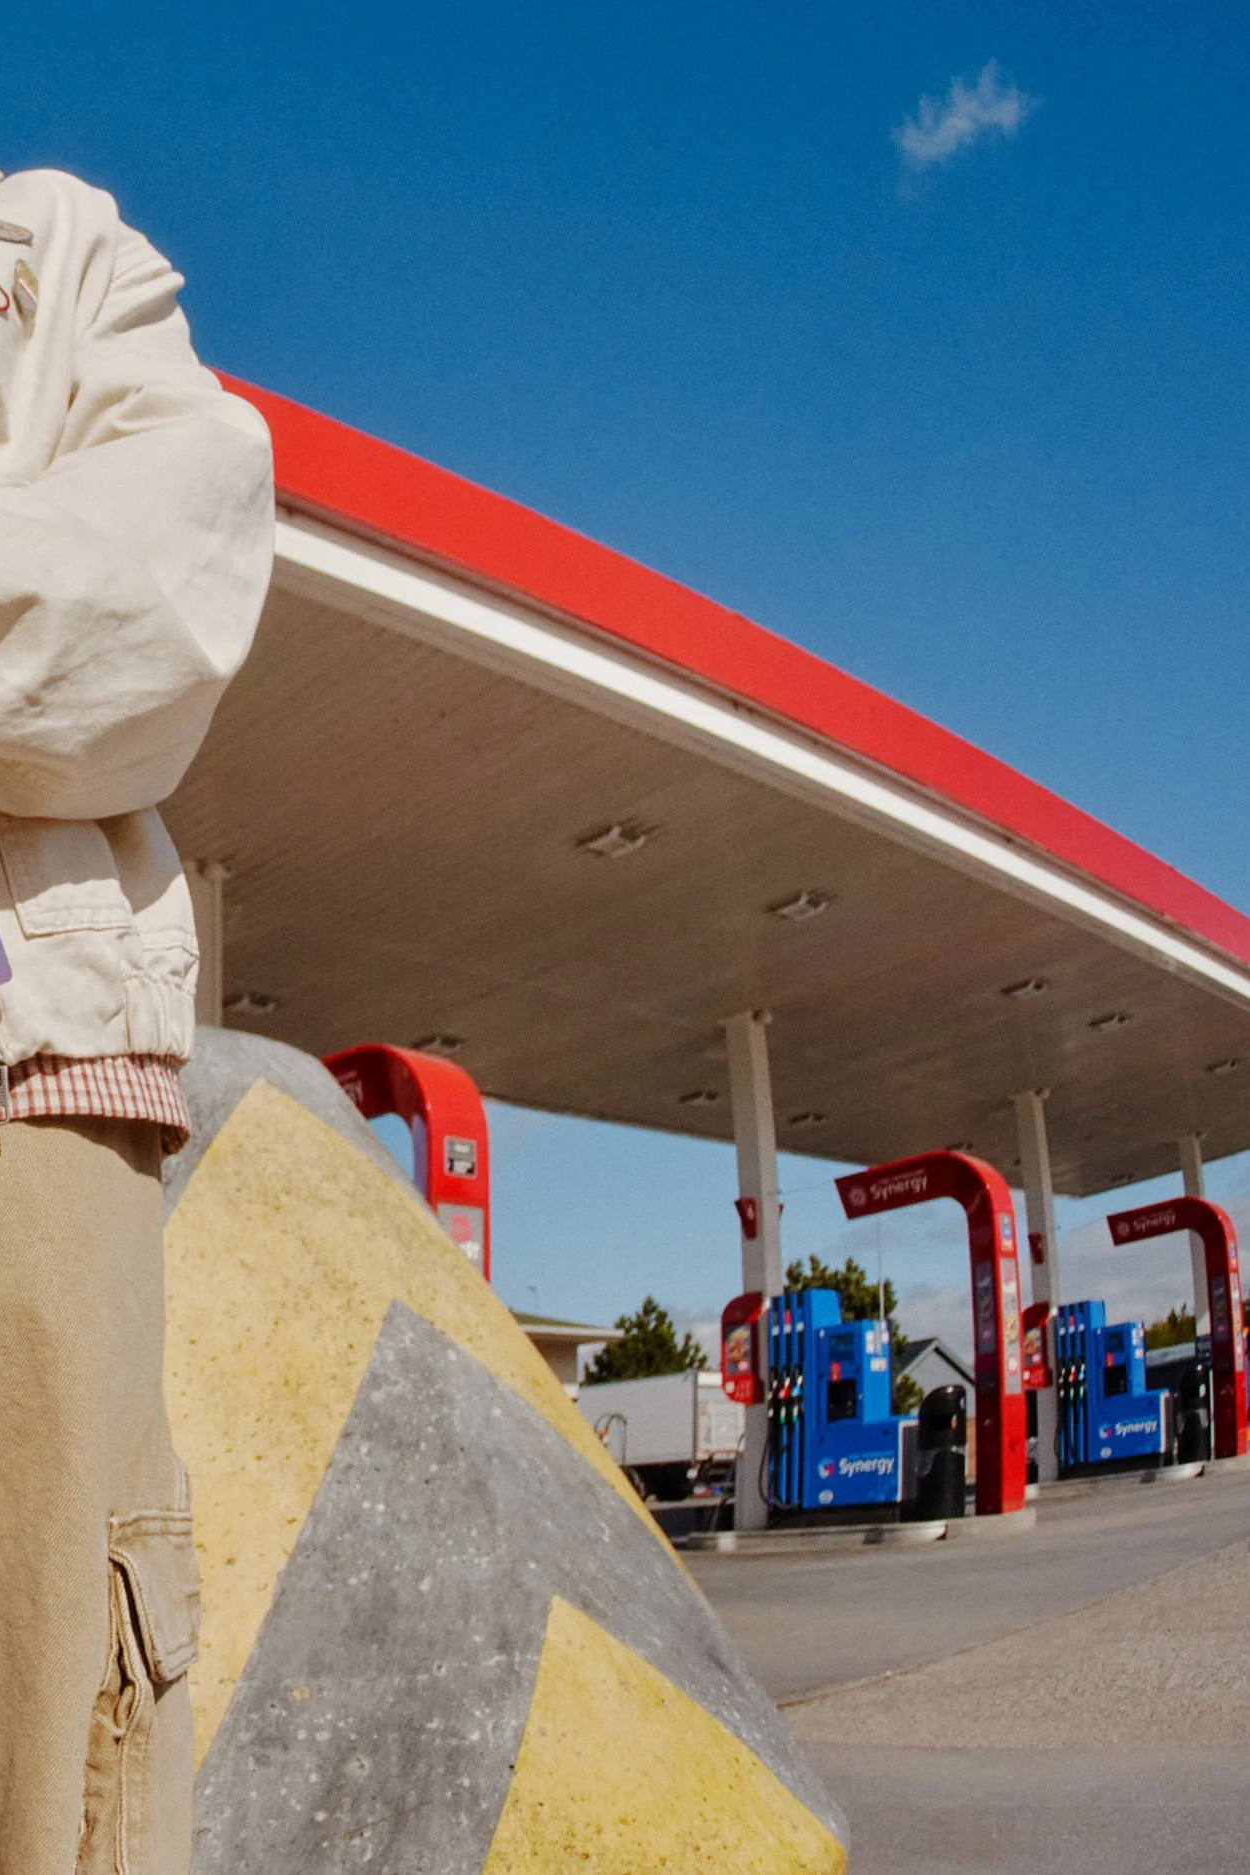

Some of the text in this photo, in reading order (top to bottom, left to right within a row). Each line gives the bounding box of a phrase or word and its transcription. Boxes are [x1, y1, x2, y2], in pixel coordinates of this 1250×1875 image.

[870, 1175, 928, 1201] Synergy
[1132, 1211, 1176, 1232] Synergy
[1115, 1420, 1158, 1437] Synergy
[839, 1457, 895, 1478] Synergy
